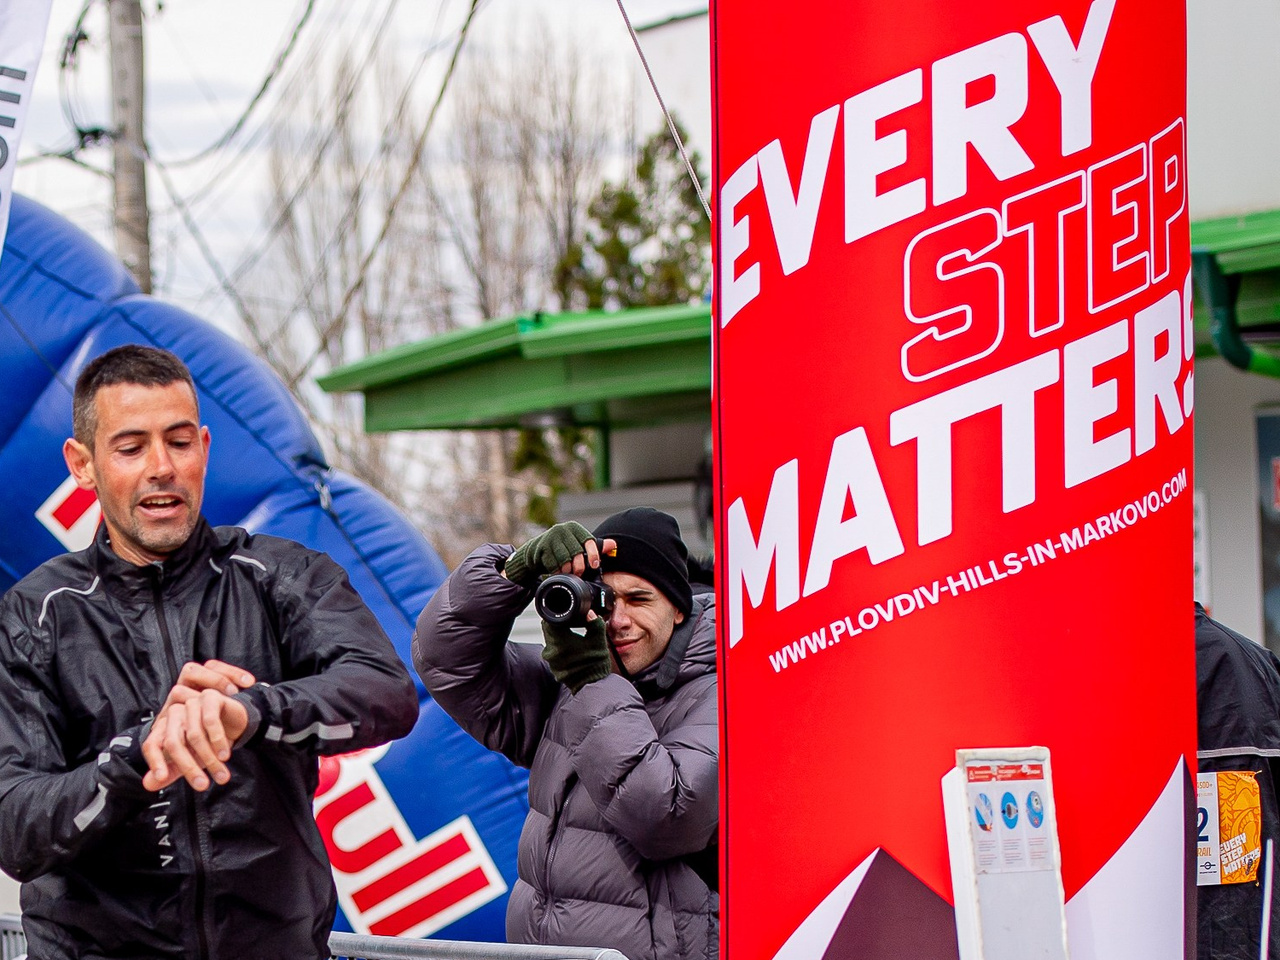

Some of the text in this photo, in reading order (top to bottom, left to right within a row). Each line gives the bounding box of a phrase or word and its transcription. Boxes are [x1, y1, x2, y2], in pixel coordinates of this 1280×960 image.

[720, 0, 1117, 329] EVERY
[901, 116, 1186, 382] STEP
[769, 468, 1187, 672] WWW.PLOVDIV-HILLS-IN-MARKOVO.COM
[314, 756, 491, 937] ull
